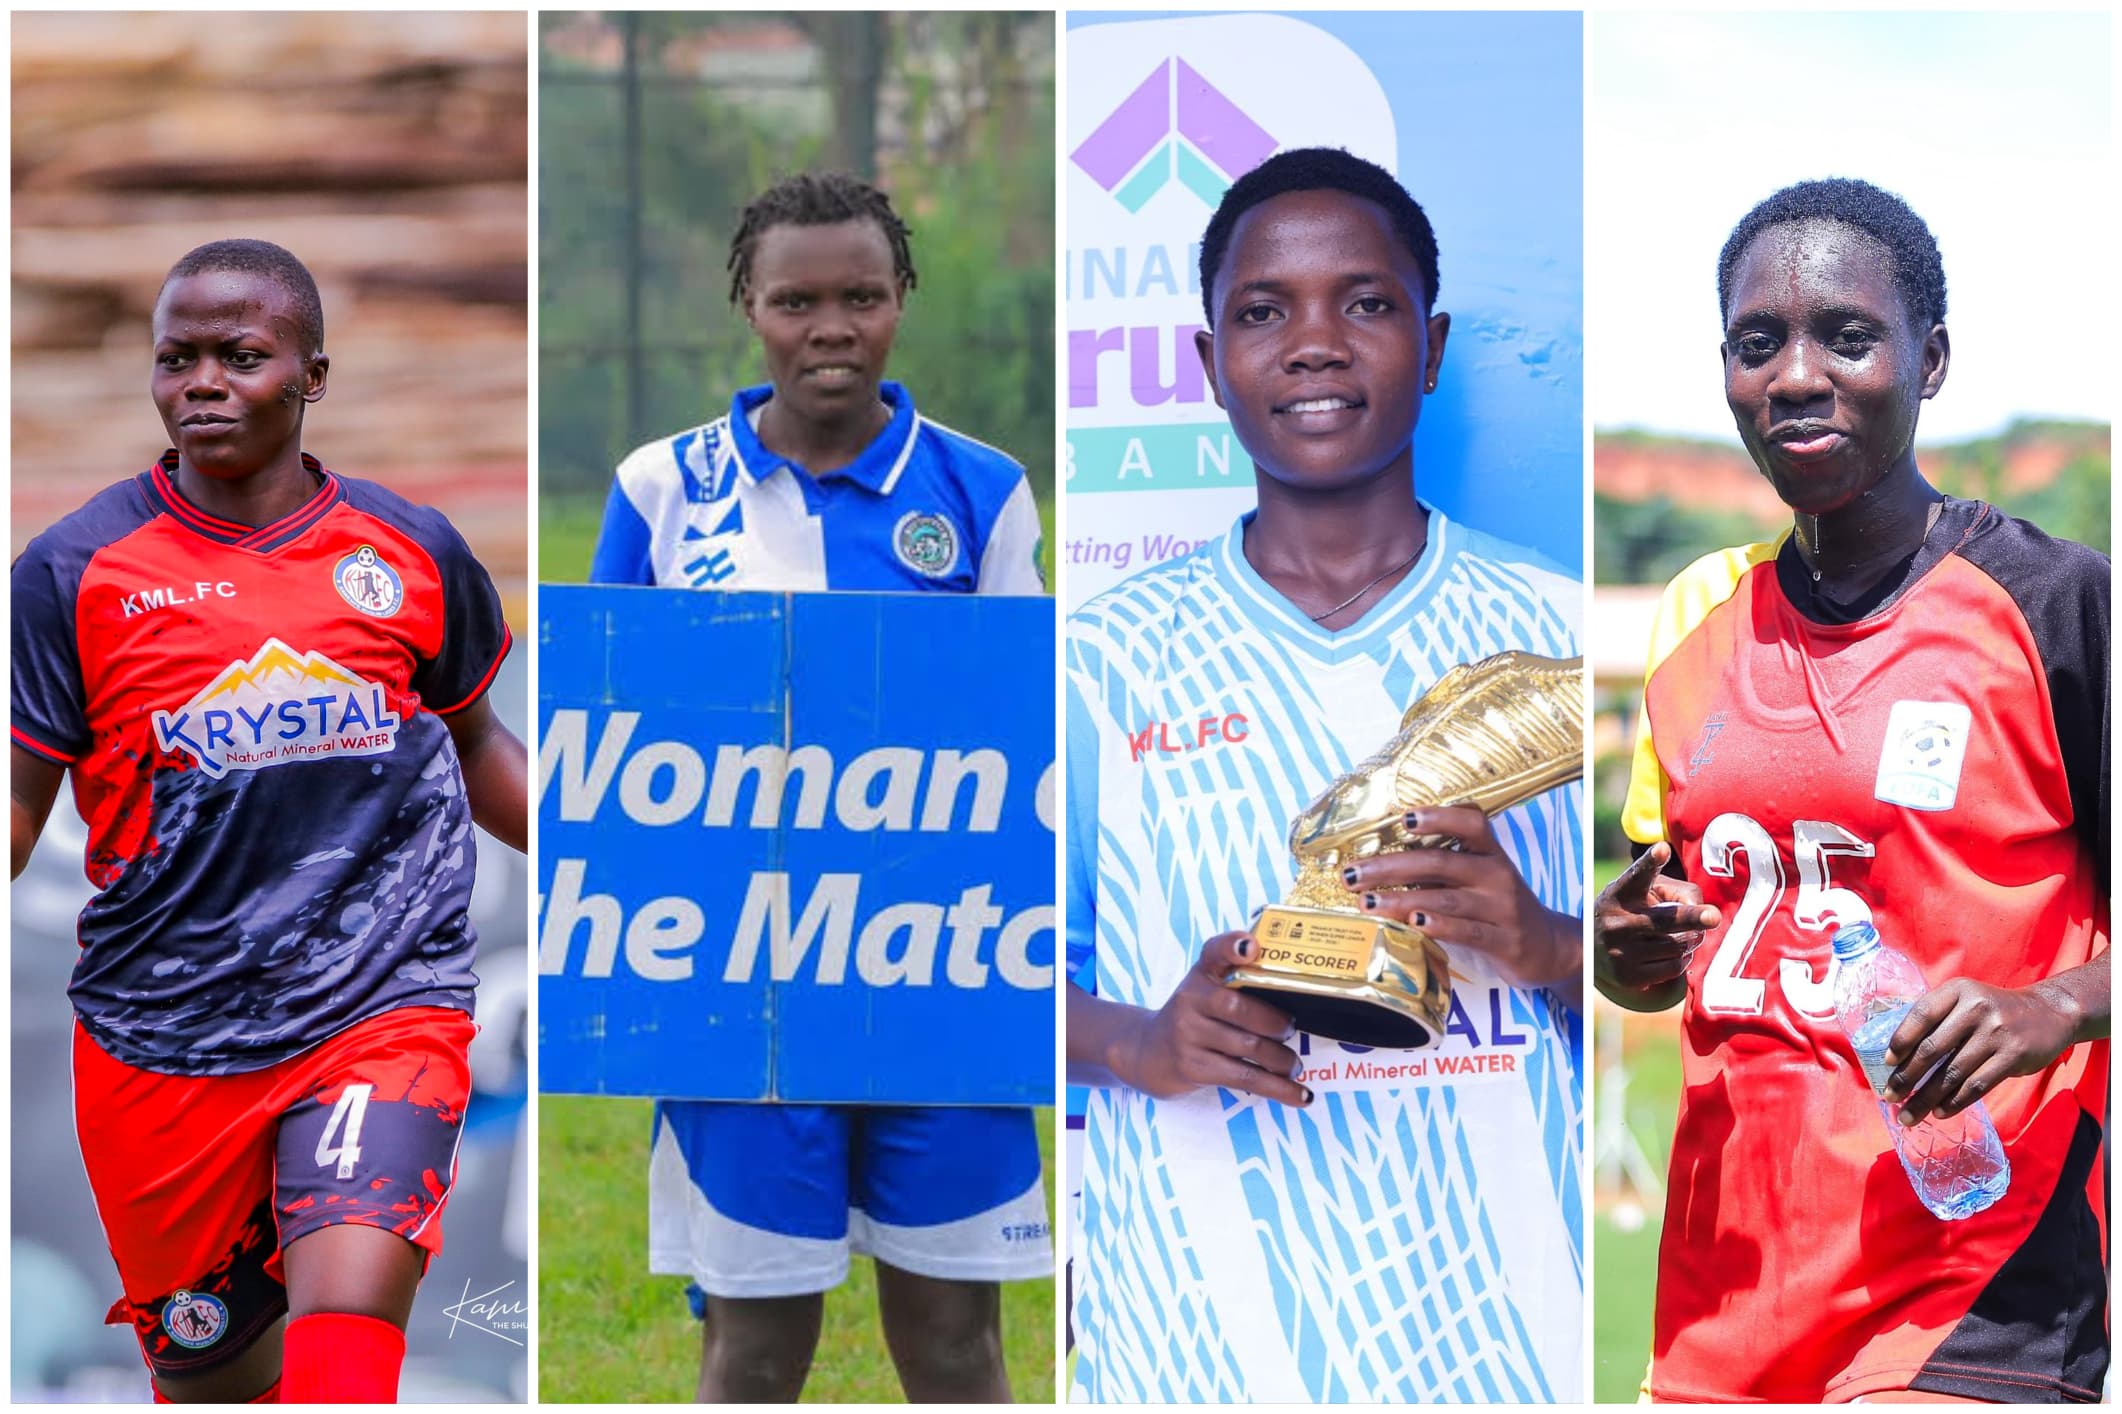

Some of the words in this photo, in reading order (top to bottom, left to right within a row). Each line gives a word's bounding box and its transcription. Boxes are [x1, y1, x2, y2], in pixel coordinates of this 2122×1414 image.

[119, 581, 237, 618] KML.FC
[158, 689, 395, 772] KRYSTAL
[226, 746, 277, 764] Natural
[281, 740, 335, 756] Mineral
[340, 732, 389, 750] WATER
[538, 709, 1010, 832] Woman
[538, 858, 706, 982] he
[1702, 812, 1876, 1022] 25
[1260, 947, 1292, 961] TOP
[1293, 952, 1358, 971] SCORER
[1345, 1057, 1427, 1080] Mineral
[1434, 1054, 1516, 1076] WATER
[315, 1083, 374, 1179] 4
